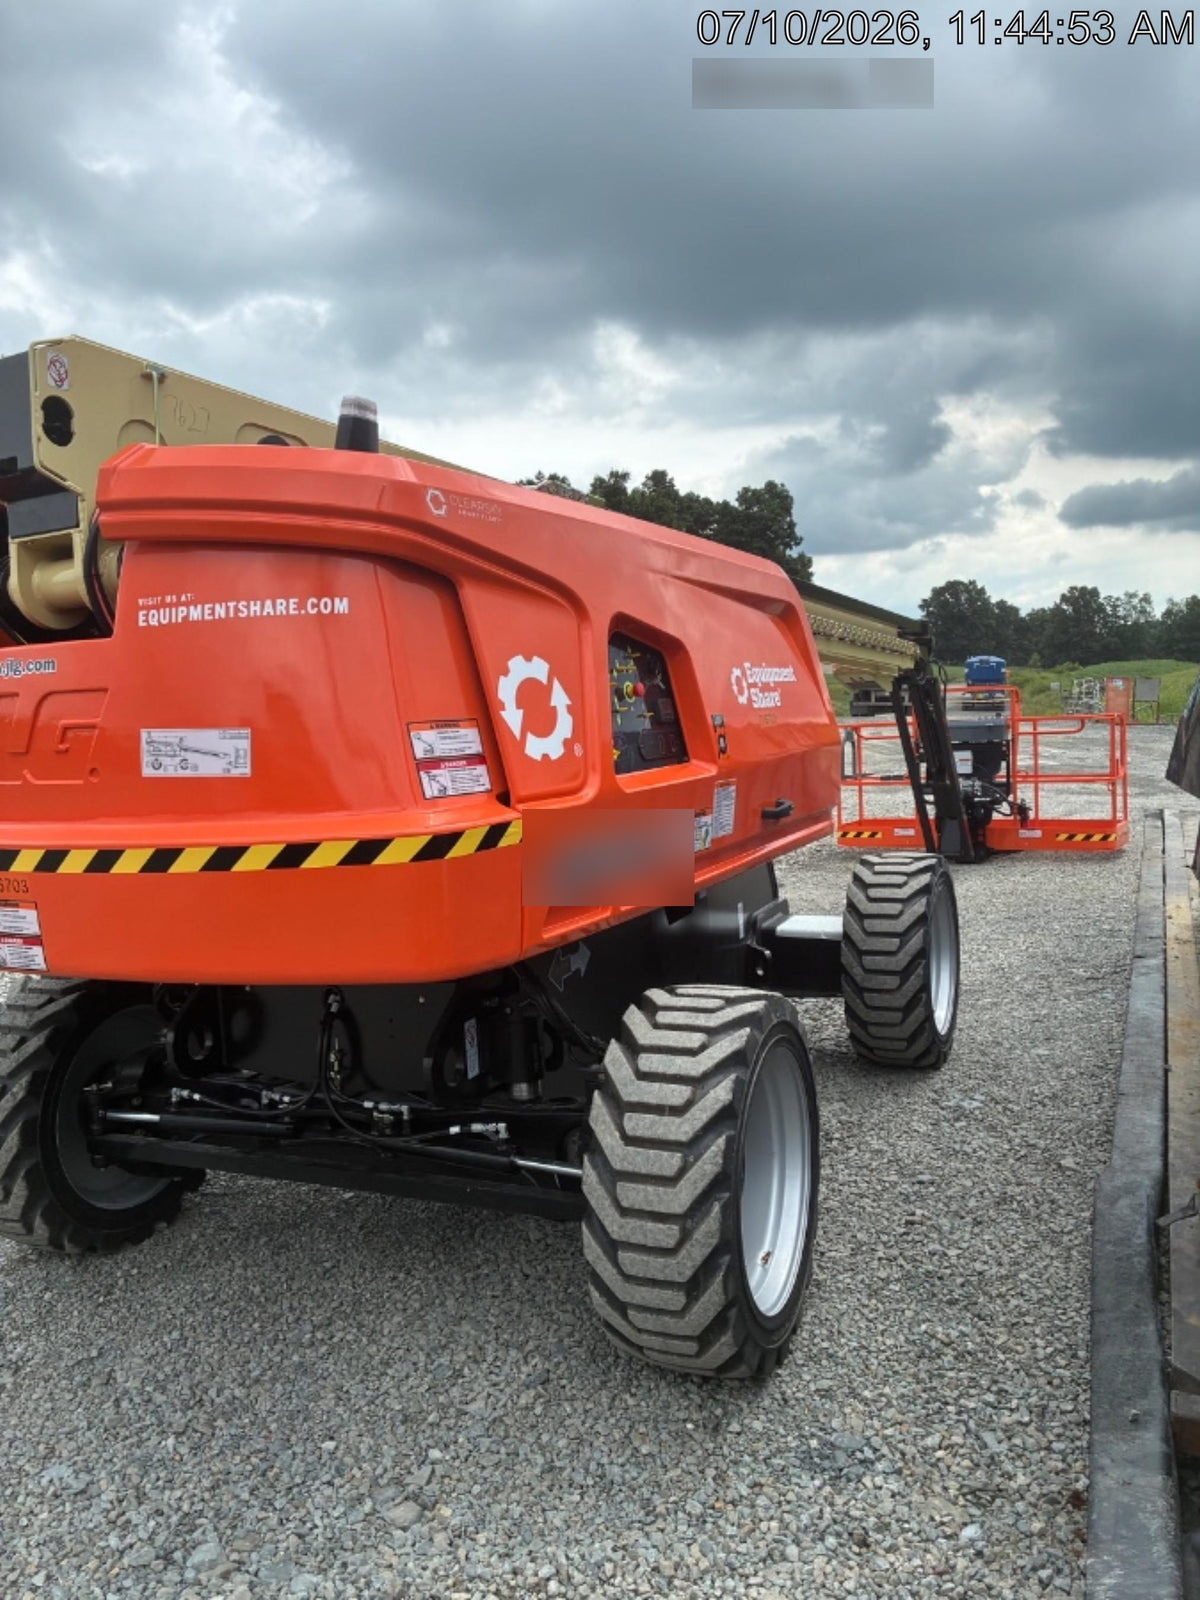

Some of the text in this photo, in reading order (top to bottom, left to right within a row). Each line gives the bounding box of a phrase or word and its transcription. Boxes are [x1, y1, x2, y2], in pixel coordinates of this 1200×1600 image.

[138, 597, 162, 607] VISIT
[165, 594, 177, 604] US
[138, 597, 349, 627] EQUIPMENTSHARE.COM
